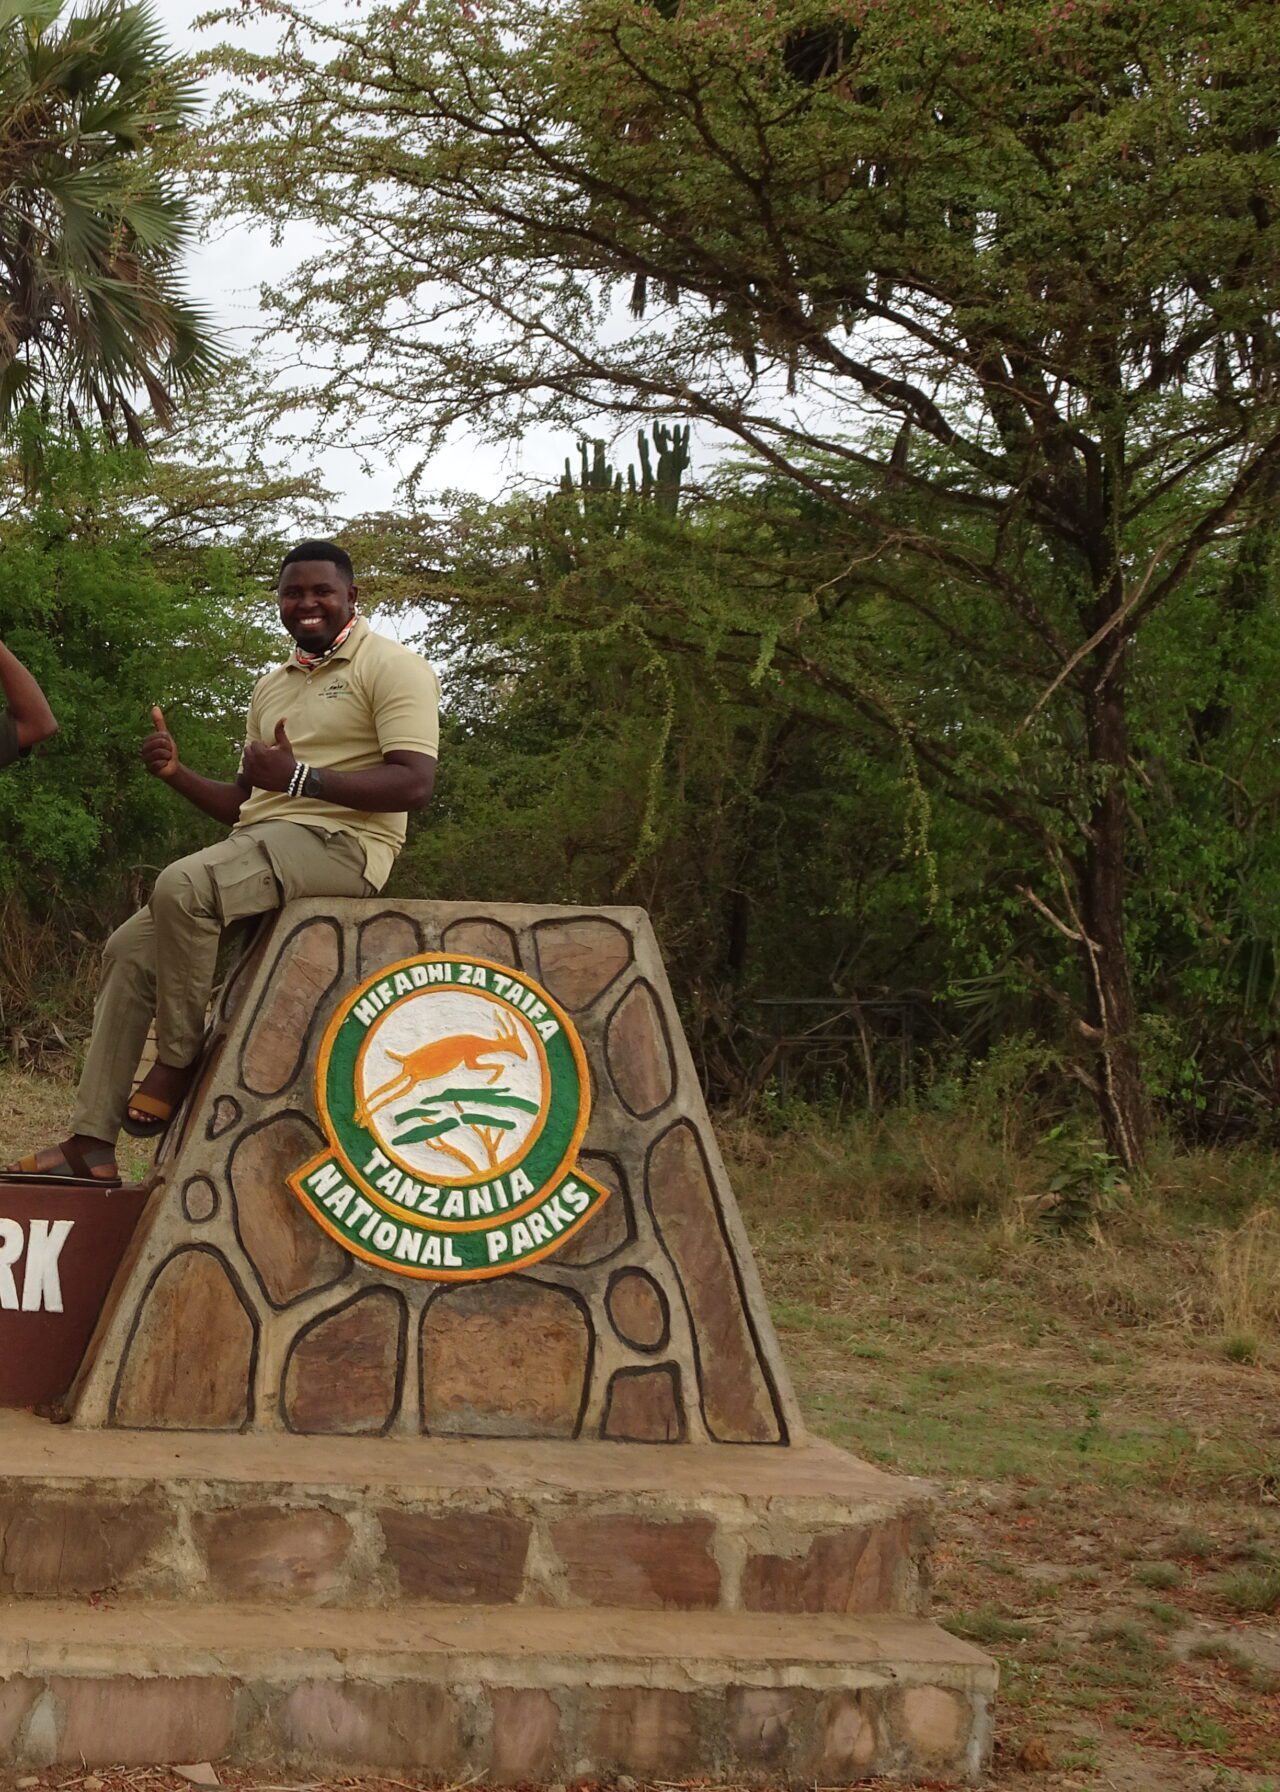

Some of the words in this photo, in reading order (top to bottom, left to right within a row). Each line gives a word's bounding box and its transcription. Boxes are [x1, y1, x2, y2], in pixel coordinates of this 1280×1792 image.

[353, 963, 451, 1027] HIFADHI
[458, 963, 487, 987] ZA
[492, 973, 560, 1042] TAIFA
[307, 1163, 463, 1267] NATIONAL
[485, 1182, 591, 1263] PARKS
[362, 1148, 535, 1219] TANZANIA
